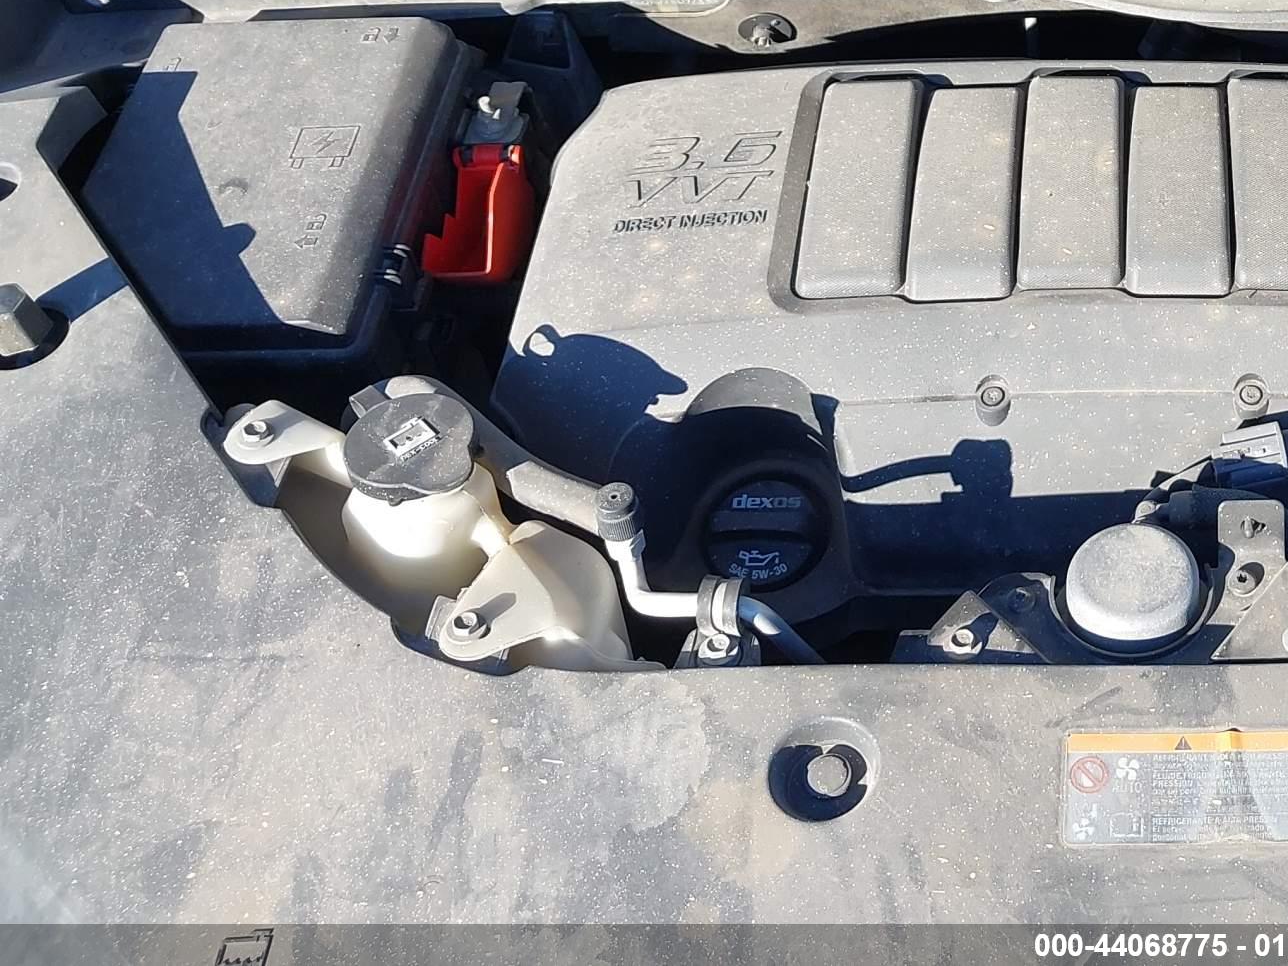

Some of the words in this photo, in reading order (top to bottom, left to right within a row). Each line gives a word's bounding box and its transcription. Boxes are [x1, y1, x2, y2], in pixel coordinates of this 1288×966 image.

[626, 130, 783, 176] 3.6
[626, 170, 775, 208] VVT
[613, 215, 677, 233] DIRECT
[678, 209, 769, 229] INJECTION
[731, 494, 801, 509] dexos
[728, 562, 750, 578] SAE
[751, 562, 788, 580] 5W-30
